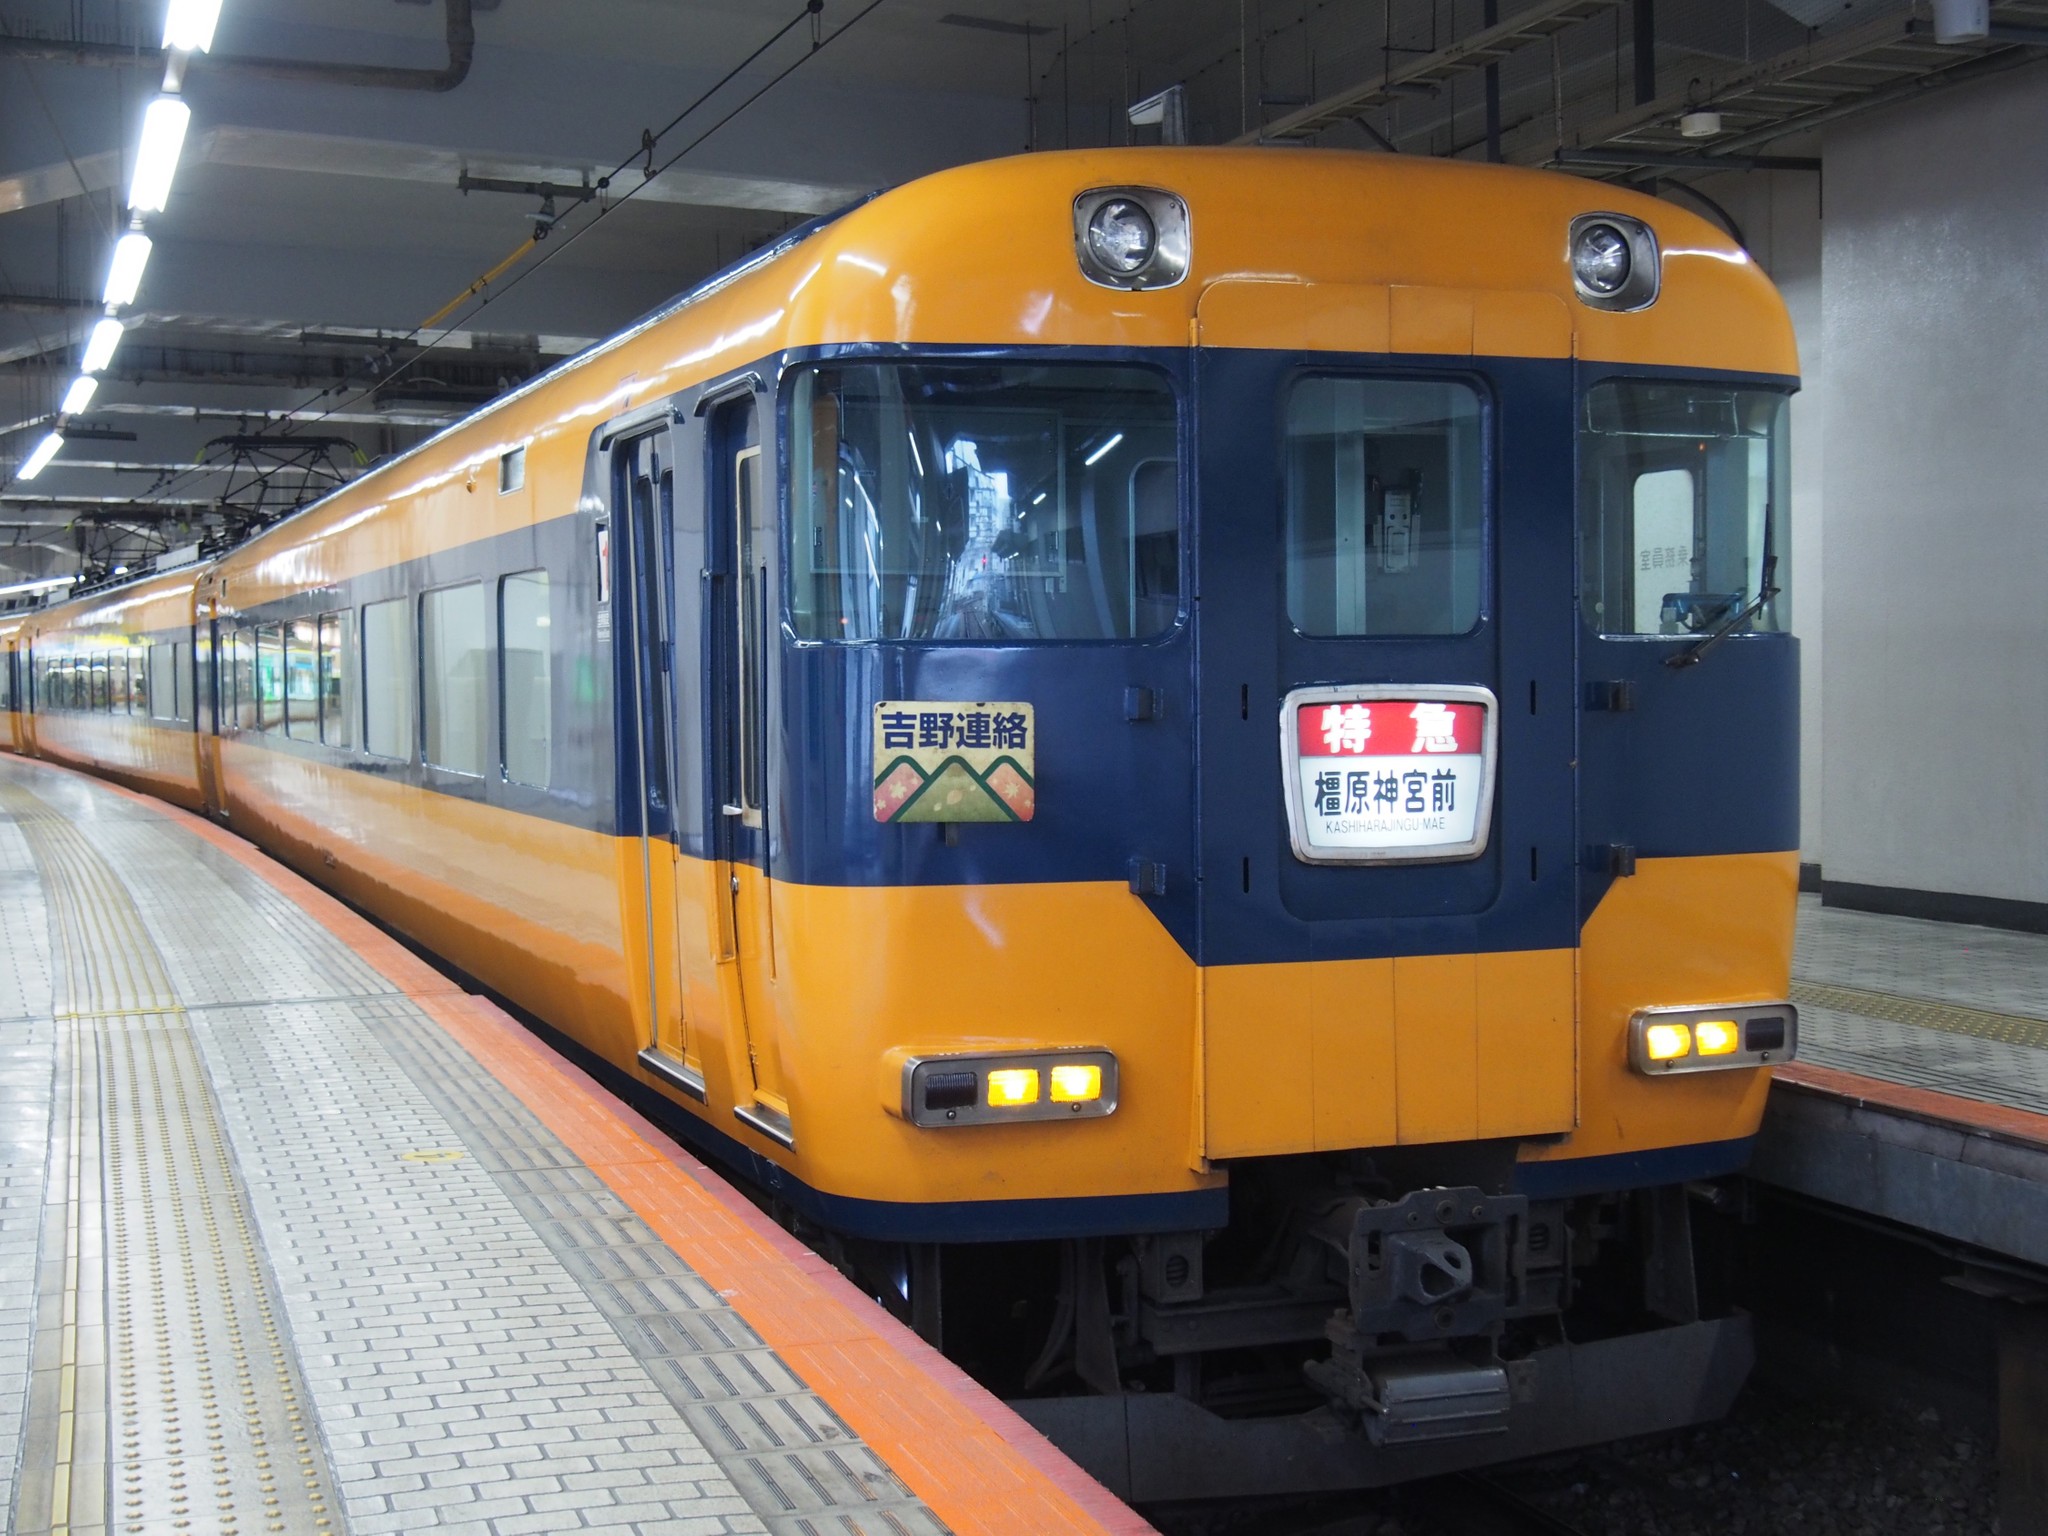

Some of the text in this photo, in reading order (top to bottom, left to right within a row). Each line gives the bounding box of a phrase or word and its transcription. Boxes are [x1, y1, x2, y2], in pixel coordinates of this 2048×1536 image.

[882, 711, 1028, 749] 吉野連絡
[1314, 769, 1456, 817] 橿原神宮前
